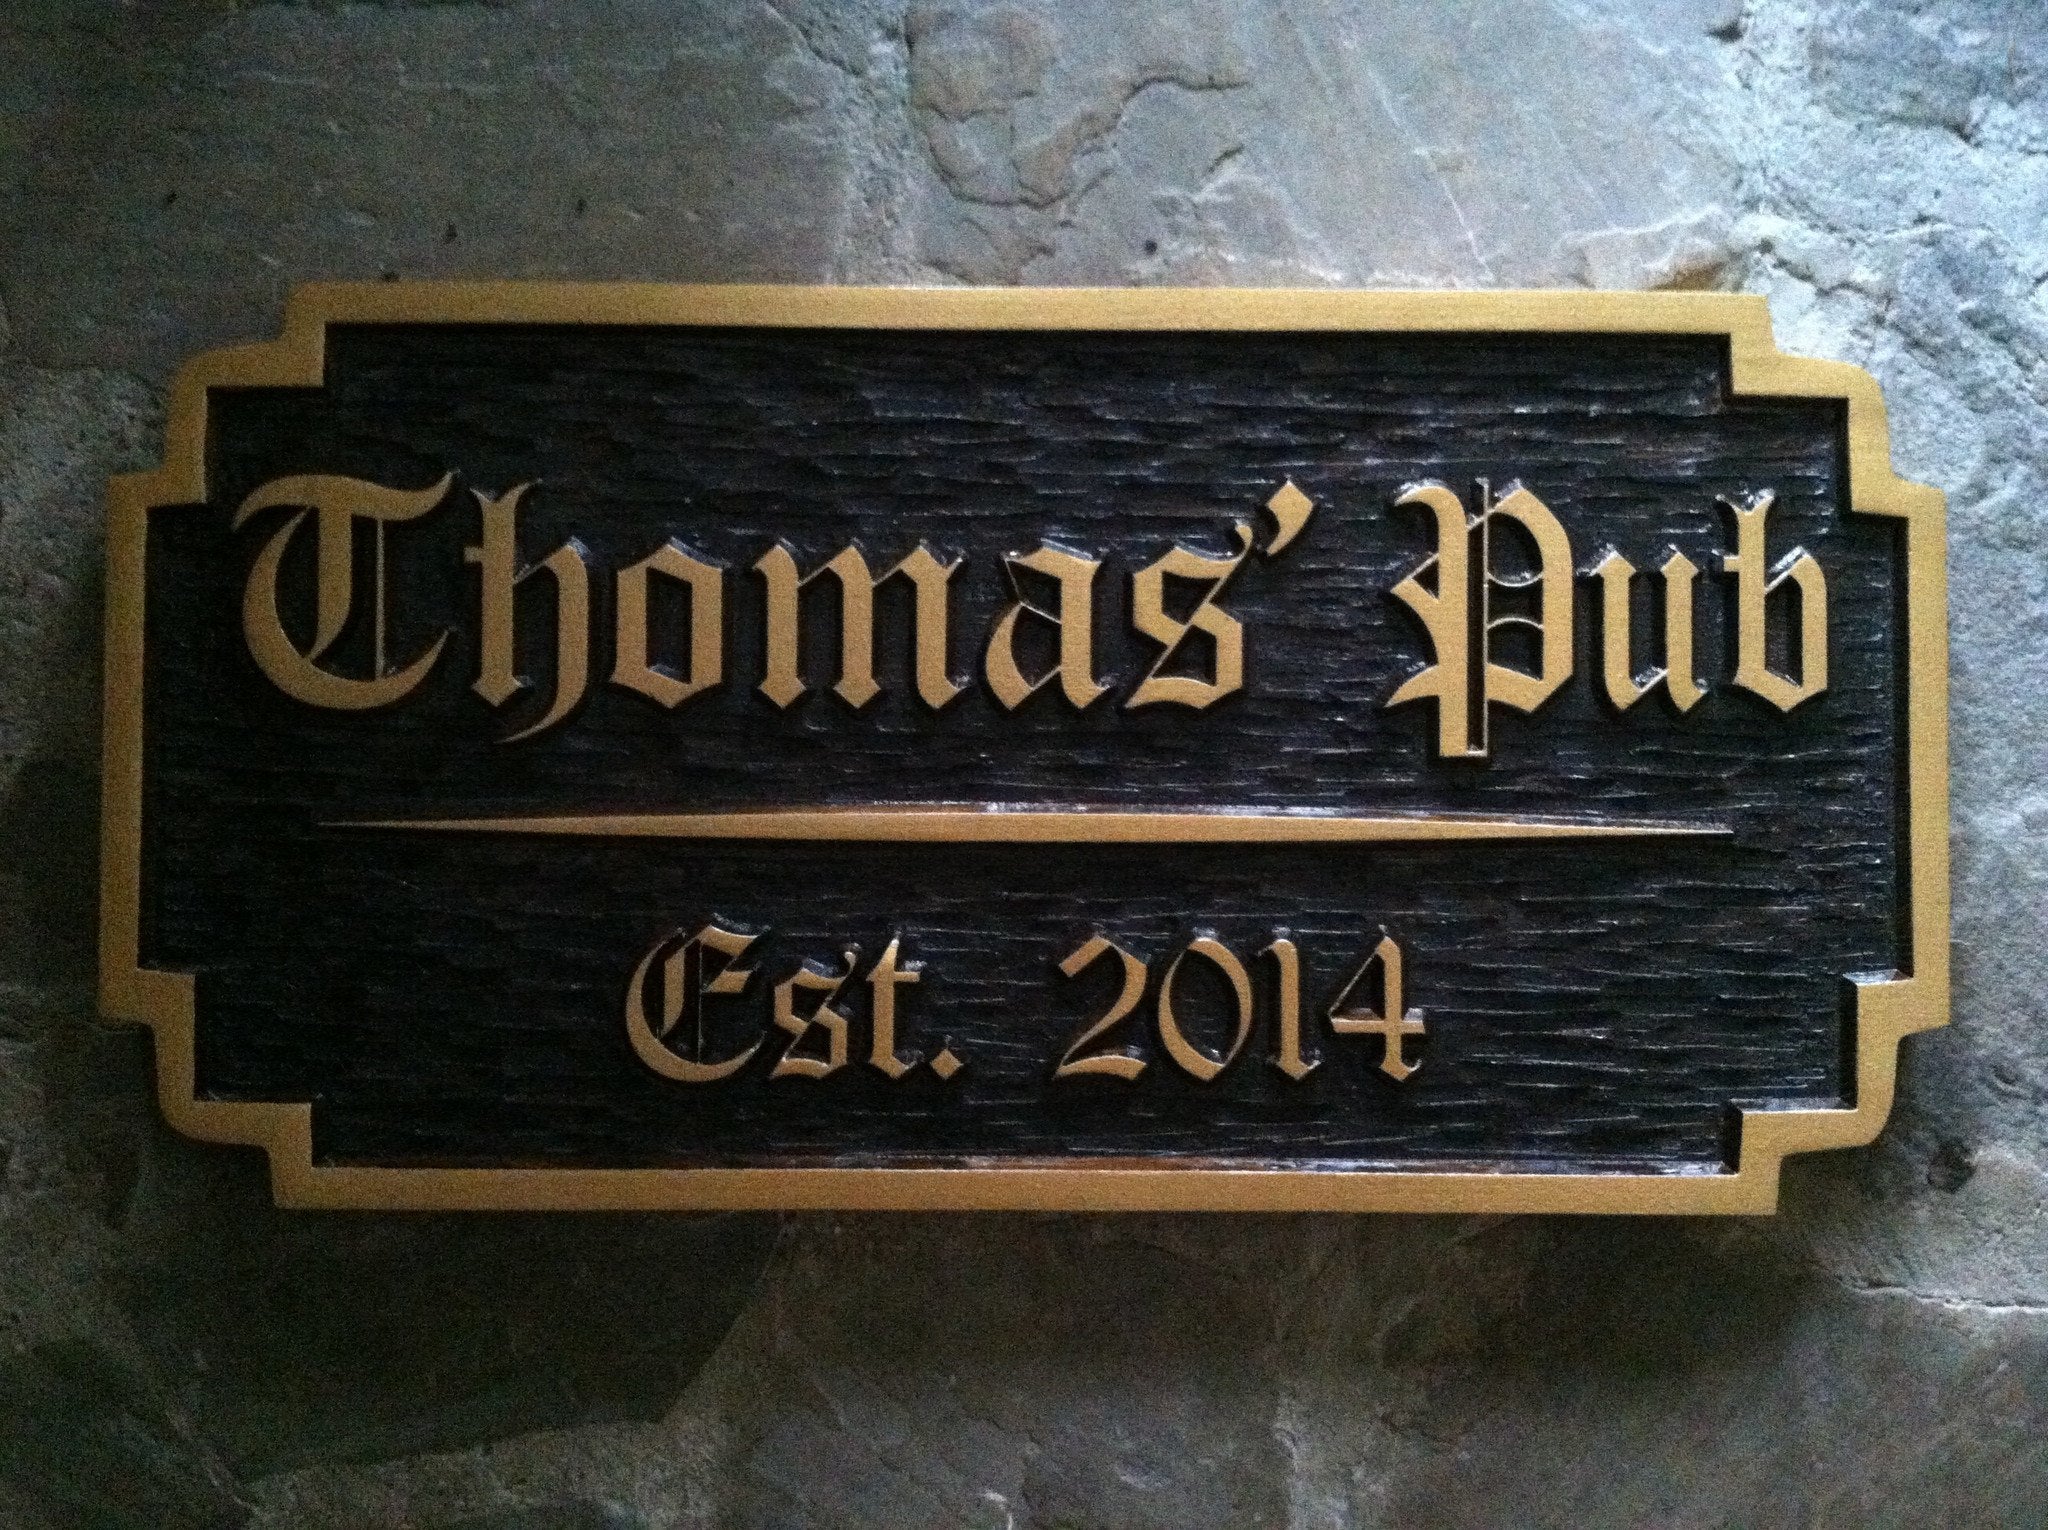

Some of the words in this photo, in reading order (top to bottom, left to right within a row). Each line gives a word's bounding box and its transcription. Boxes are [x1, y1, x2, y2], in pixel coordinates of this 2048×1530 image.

[232, 469, 1315, 744] Thomas'
[1384, 476, 1829, 758] Pub
[625, 920, 965, 1083] Est.
[1055, 930, 1427, 1083] 2014
